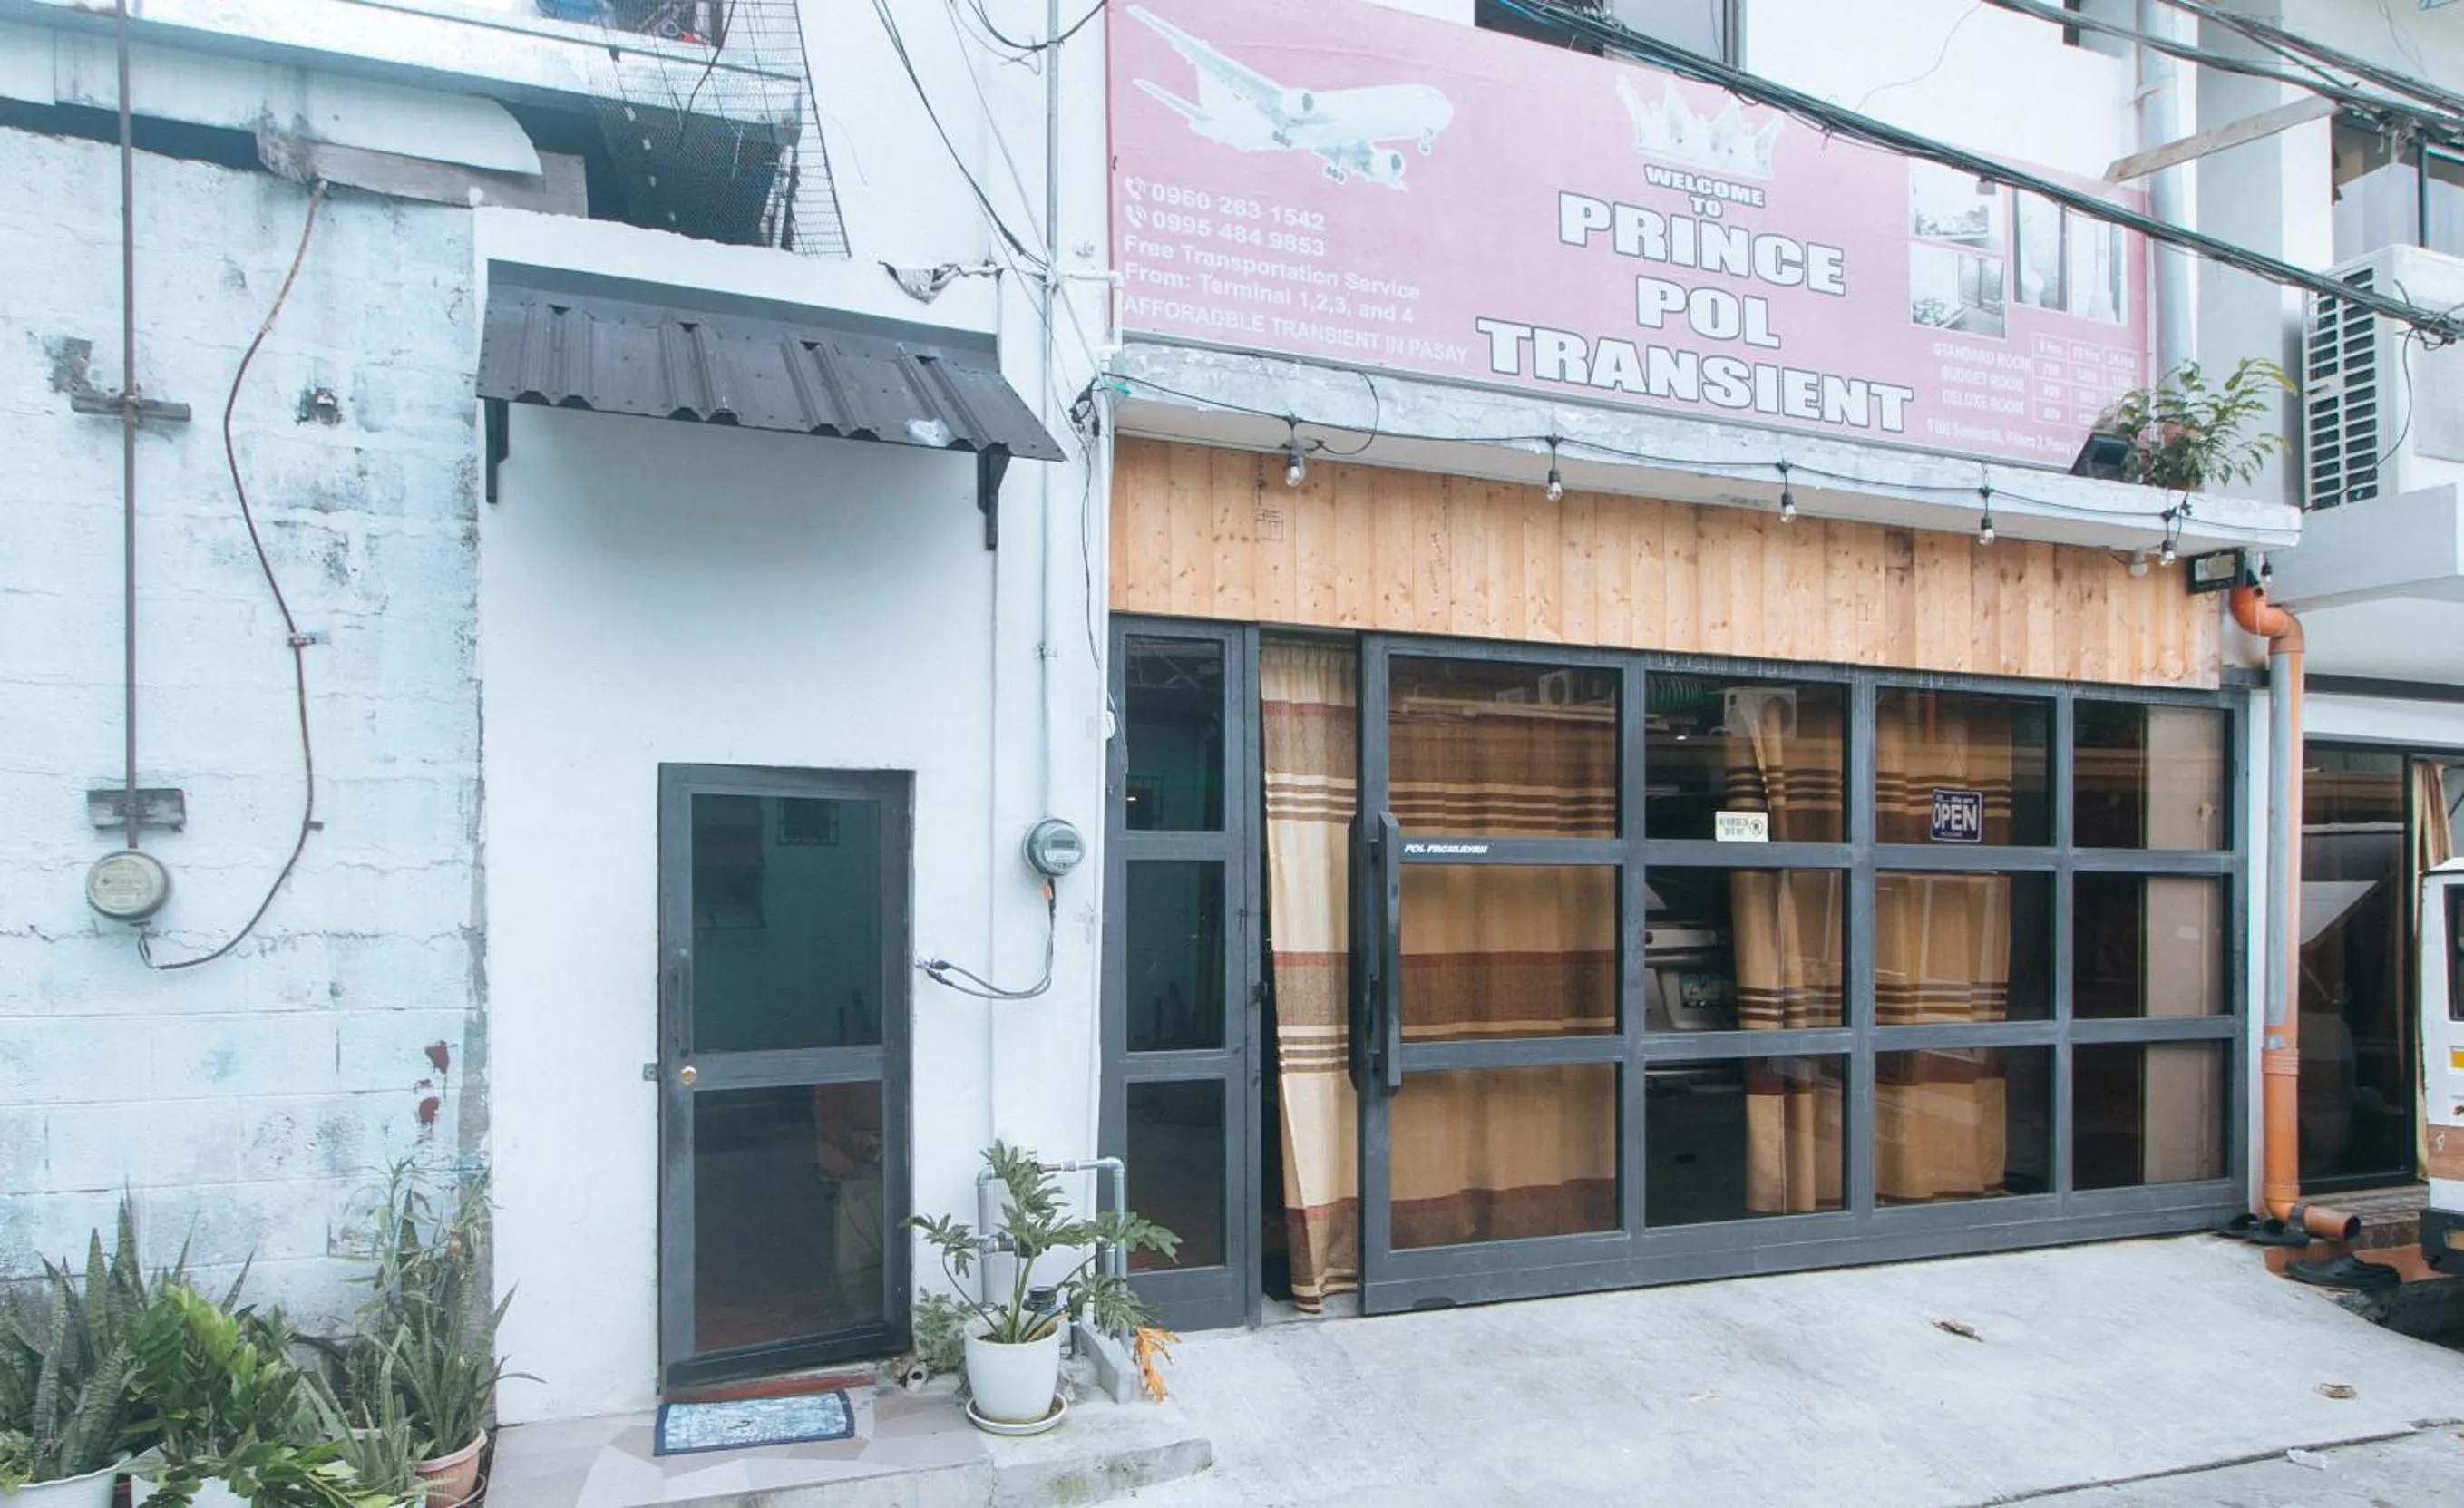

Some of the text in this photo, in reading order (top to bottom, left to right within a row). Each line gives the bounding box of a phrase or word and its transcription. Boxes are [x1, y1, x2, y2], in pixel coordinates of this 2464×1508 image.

[1151, 183, 1325, 231] 0960 263 1542
[1643, 163, 1766, 208] WELCOME
[1689, 193, 1724, 219] TO
[1152, 210, 1326, 257] 0995 484 9853
[1558, 190, 1846, 297] PRINCE
[1124, 234, 1420, 301] Free Transportation Service
[1125, 261, 1191, 288] From:
[1201, 272, 1291, 306] Terminal
[1358, 303, 1395, 323] and
[1401, 307, 1415, 324] 4
[1635, 275, 1781, 350] POL
[1271, 316, 1380, 351] TRANSIENT
[1386, 335, 1407, 355] IN
[1408, 339, 1468, 365] PASAY
[1475, 316, 1914, 433] TRANSIENT
[1942, 388, 1989, 410] DELUXE
[1933, 803, 1978, 831] OPEN
